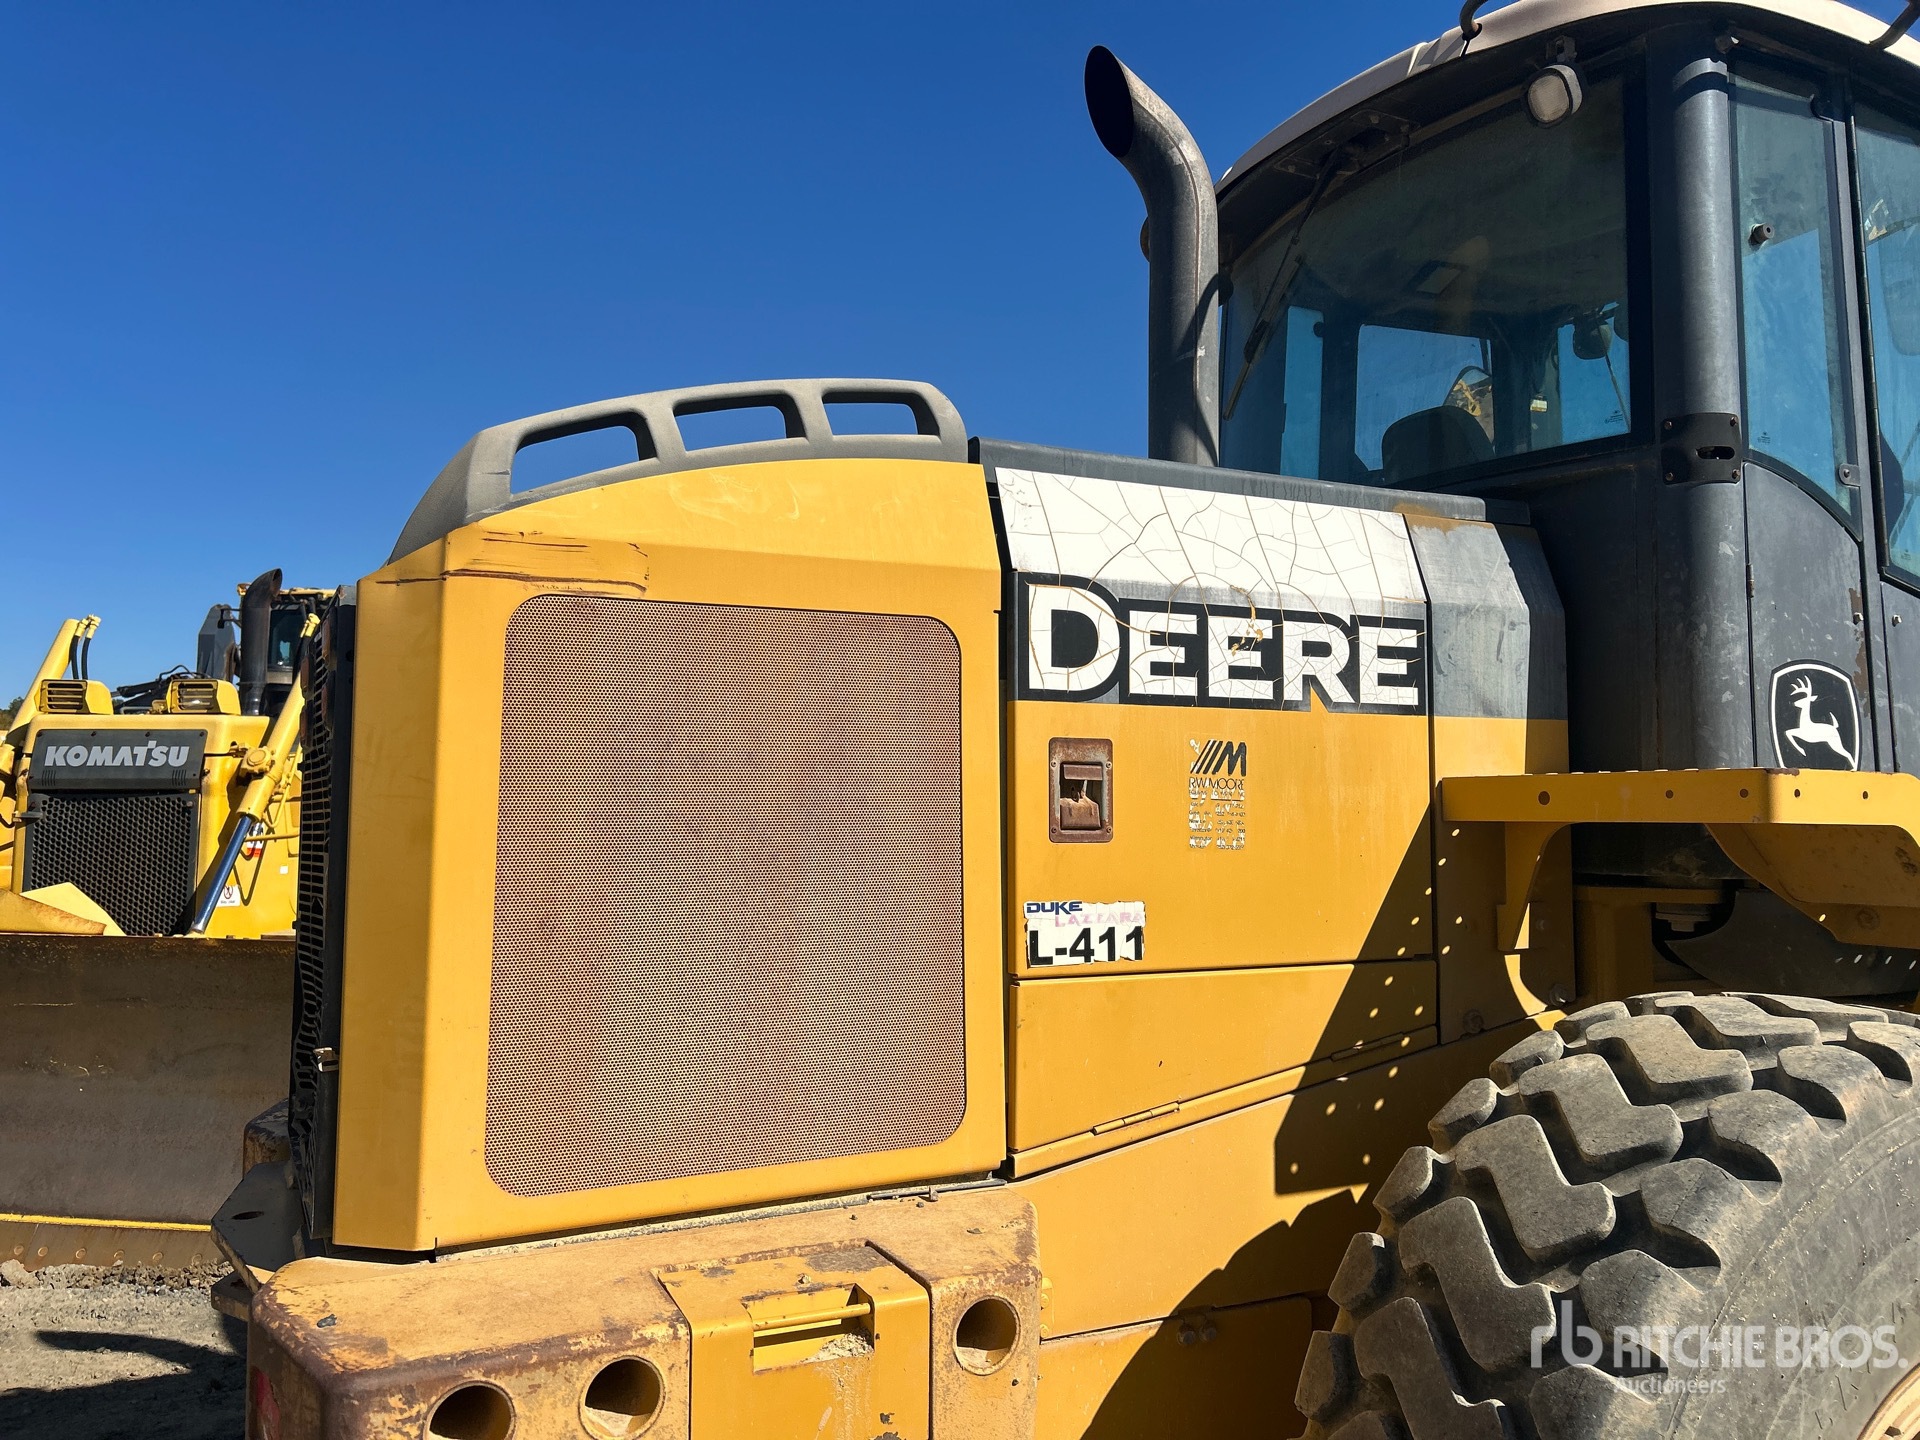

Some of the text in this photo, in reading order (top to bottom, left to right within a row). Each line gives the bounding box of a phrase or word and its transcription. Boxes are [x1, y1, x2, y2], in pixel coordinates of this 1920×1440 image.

[1028, 584, 1419, 706] DEERE
[44, 740, 190, 767] KOMATSU
[1026, 901, 1083, 915] DUKE
[1028, 925, 1143, 966] L-411
